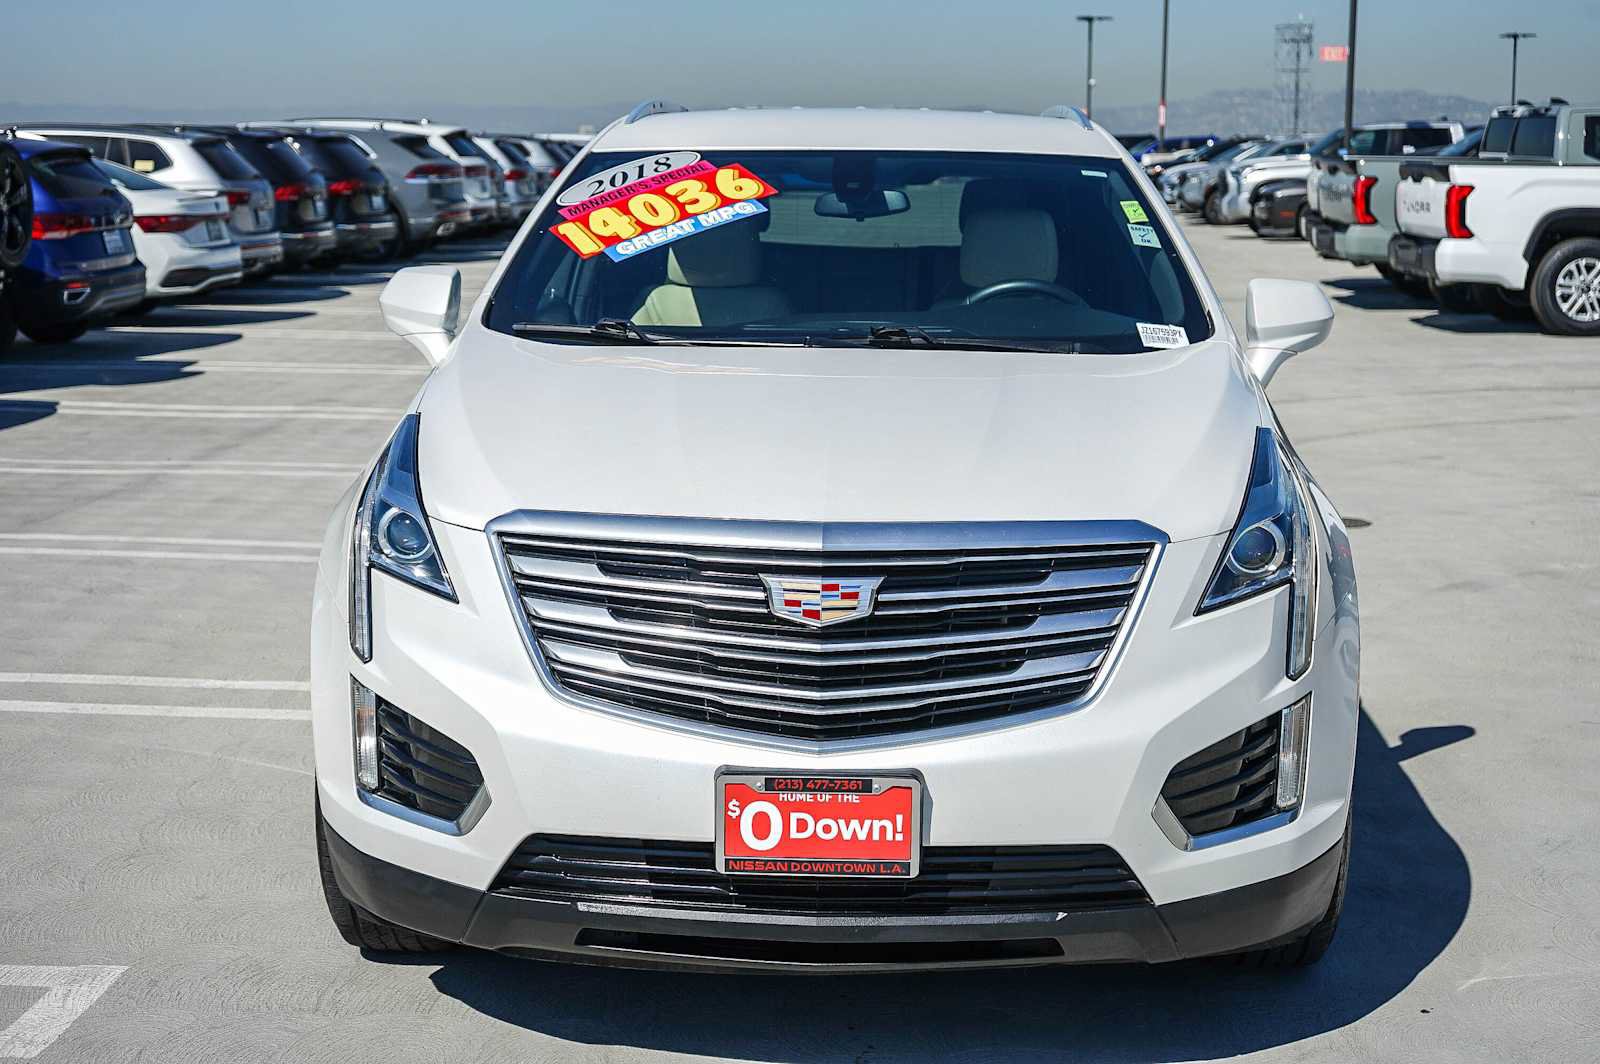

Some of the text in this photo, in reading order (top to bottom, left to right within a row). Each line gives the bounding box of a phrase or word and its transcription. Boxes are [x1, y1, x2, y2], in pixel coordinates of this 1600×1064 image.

[568, 163, 706, 217] MANAGER'S SPECIAL
[587, 157, 672, 198] 2018
[557, 168, 764, 256] 14036
[615, 202, 758, 256] GREAT MPG
[774, 779, 863, 791] (213) 477-7361
[838, 793, 860, 803] THE
[789, 811, 904, 841] Down!
[728, 859, 907, 874] NISSAN DOWNTOWN L.A.
